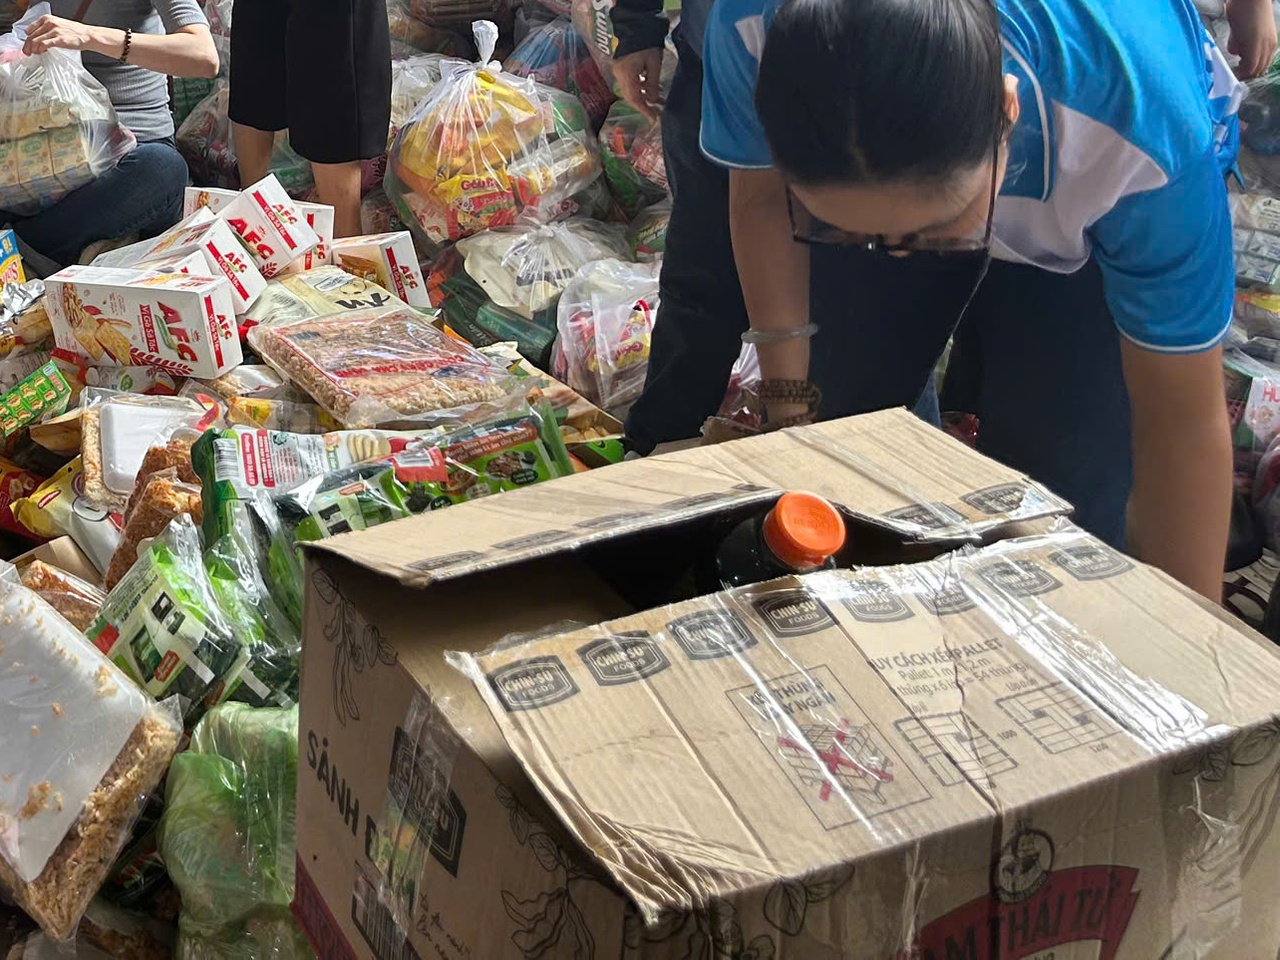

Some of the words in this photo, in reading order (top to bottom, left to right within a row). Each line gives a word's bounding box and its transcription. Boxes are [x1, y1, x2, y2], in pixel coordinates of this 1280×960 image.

[272, 203, 298, 225] AFC
[227, 218, 275, 261] AFC
[224, 251, 248, 274] AFC
[399, 265, 418, 289] AFC
[336, 292, 391, 309] An
[157, 301, 199, 362] AFC
[216, 315, 232, 340] AFC
[770, 601, 818, 622] CHIN-SU
[787, 612, 820, 626] FOODS
[613, 657, 646, 673] FOODS
[873, 653, 895, 672] UY
[895, 648, 930, 669] CÁCH
[955, 637, 1005, 661] PALLET
[522, 683, 555, 699] FOODS
